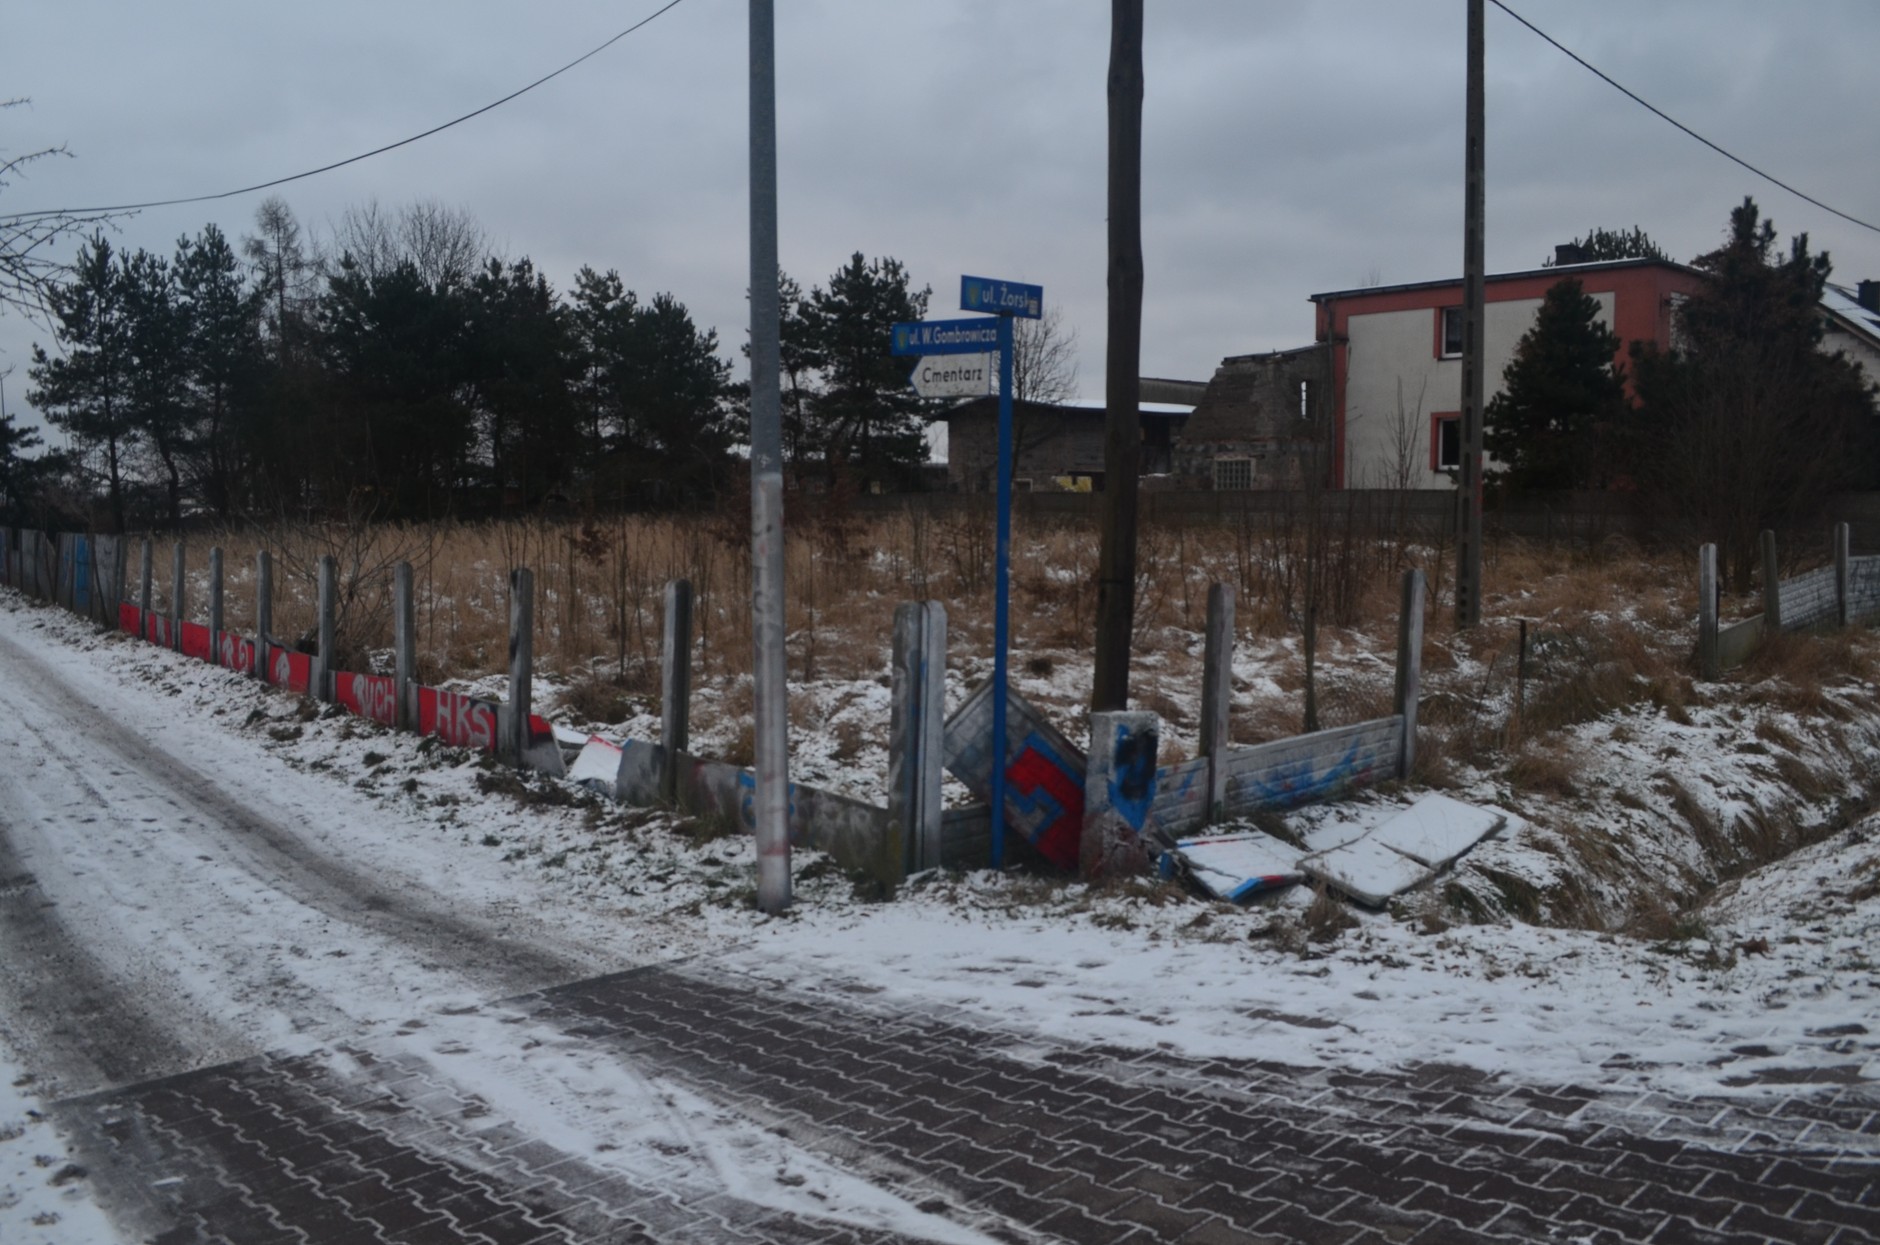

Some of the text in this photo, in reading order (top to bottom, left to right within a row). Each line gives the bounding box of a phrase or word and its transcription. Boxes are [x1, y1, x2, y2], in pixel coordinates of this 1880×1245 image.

[982, 283, 1038, 311] ul. Żorsk
[909, 327, 920, 345] ul.
[922, 367, 982, 383] Cmentarz
[437, 688, 491, 747] HKS
